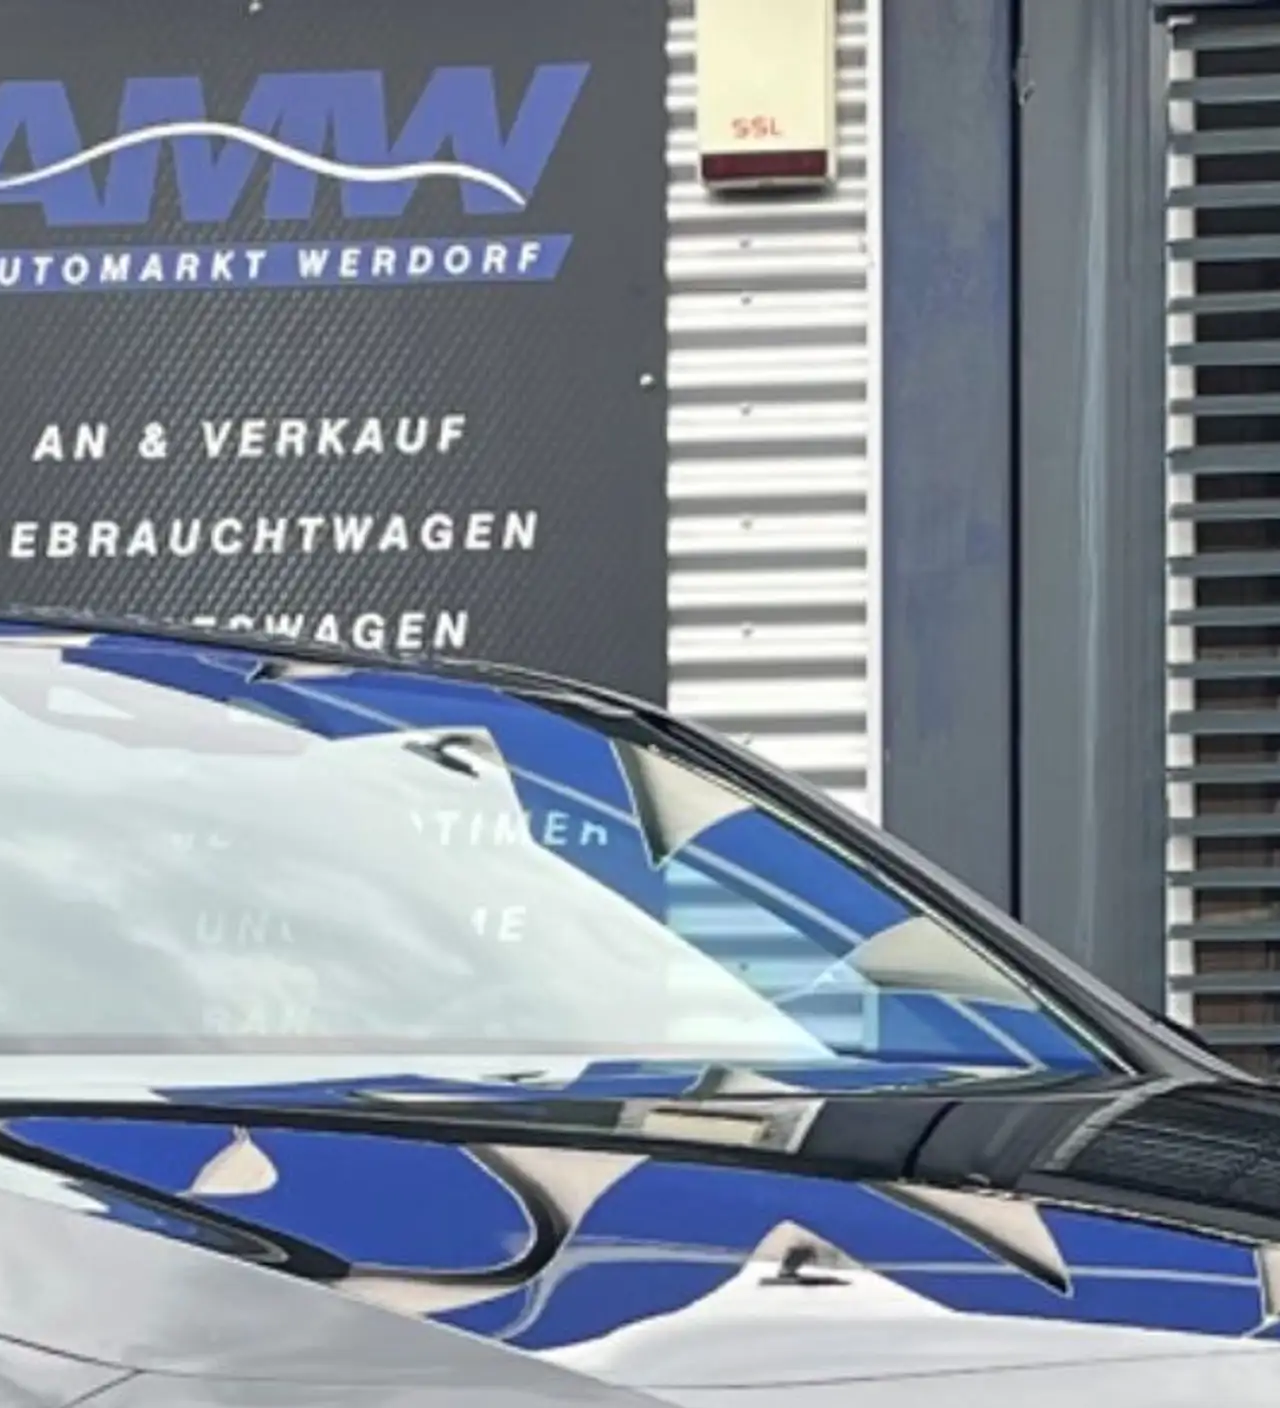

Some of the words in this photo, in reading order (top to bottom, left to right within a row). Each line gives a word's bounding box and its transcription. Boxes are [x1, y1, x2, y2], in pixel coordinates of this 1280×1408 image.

[732, 115, 783, 140] SSL
[298, 240, 544, 279] WERDORF
[31, 422, 108, 462] AN
[137, 421, 168, 459] &
[202, 414, 467, 458] VERKAUF
